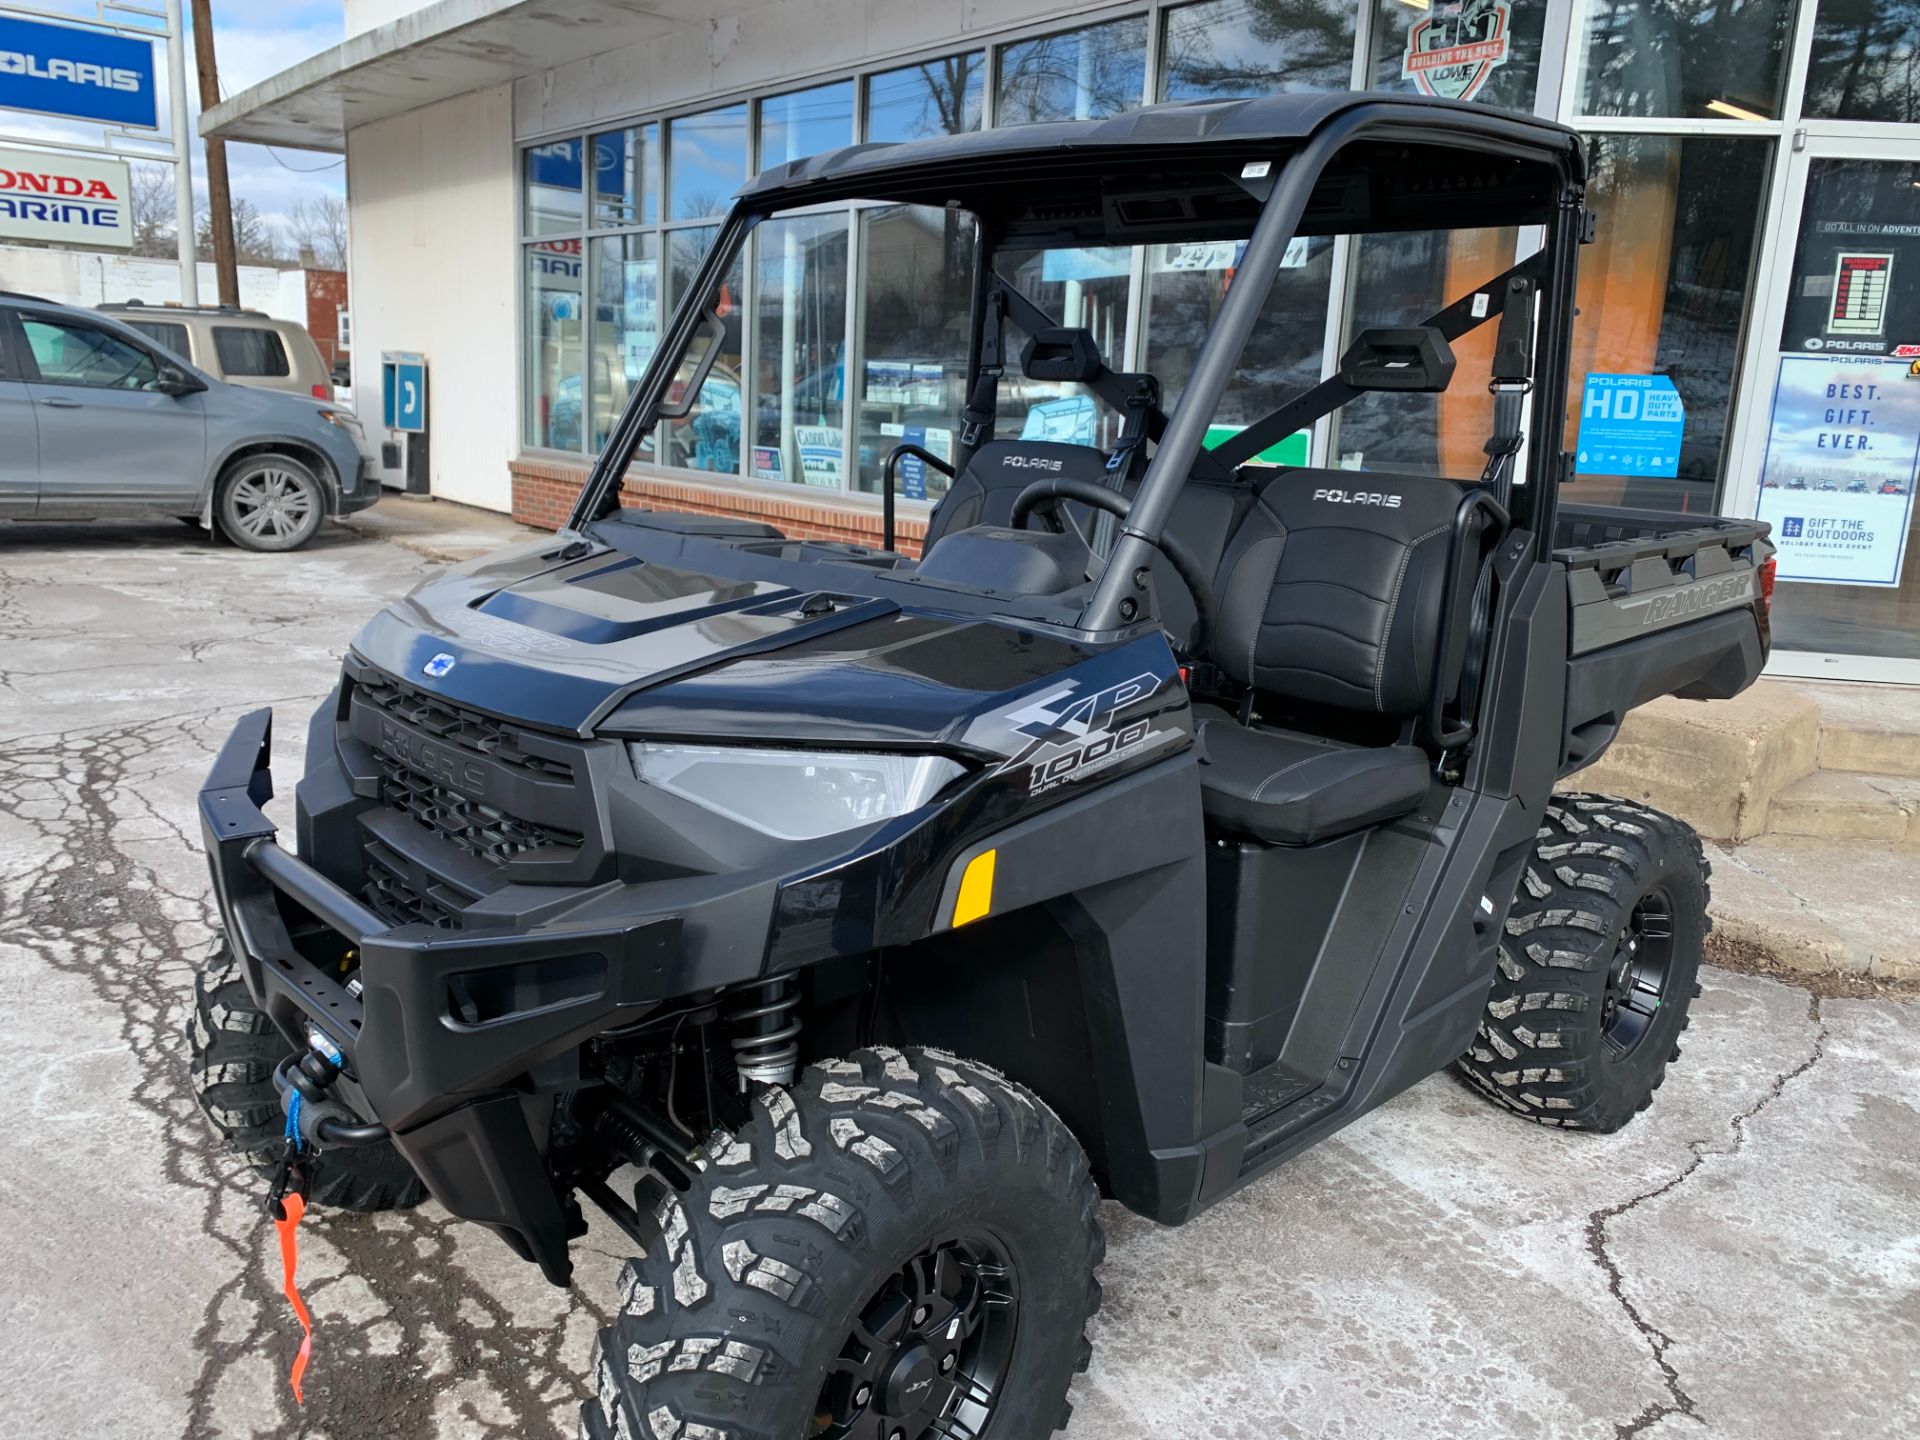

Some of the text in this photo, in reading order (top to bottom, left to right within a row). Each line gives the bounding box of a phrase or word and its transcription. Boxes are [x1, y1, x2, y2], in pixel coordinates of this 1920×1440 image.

[1411, 42, 1500, 69] BUILDING THE BEST
[0, 50, 140, 92] OLARIS
[1432, 64, 1474, 81] LOWE
[1838, 223, 1855, 233] ALL
[1856, 224, 1866, 233] IN
[1867, 224, 1880, 233] ON
[1825, 340, 1885, 351] POLARIS
[1830, 356, 1883, 365] POLARIS
[1588, 377, 1653, 388] POLARIS
[1648, 394, 1680, 402] HEAVY
[1826, 383, 1881, 400] BEST.
[1584, 388, 1640, 420] HD
[1647, 402, 1673, 410] DUTY
[1647, 410, 1678, 418] PARTS
[1824, 408, 1874, 425] GIFT.
[1817, 433, 1873, 450] EVER.
[1002, 456, 1063, 471] POLARIS
[1312, 489, 1402, 508] POLARIS
[1808, 517, 1865, 530] GIFT THE
[1806, 528, 1875, 542] OUTDOORS
[1643, 573, 1751, 625] RANGER
[986, 671, 1162, 780] XP
[381, 718, 485, 797] POLARIS
[1028, 718, 1151, 790] 1000
[1030, 779, 1060, 797] DUAL
[1061, 753, 1120, 784] OVERHEAD
